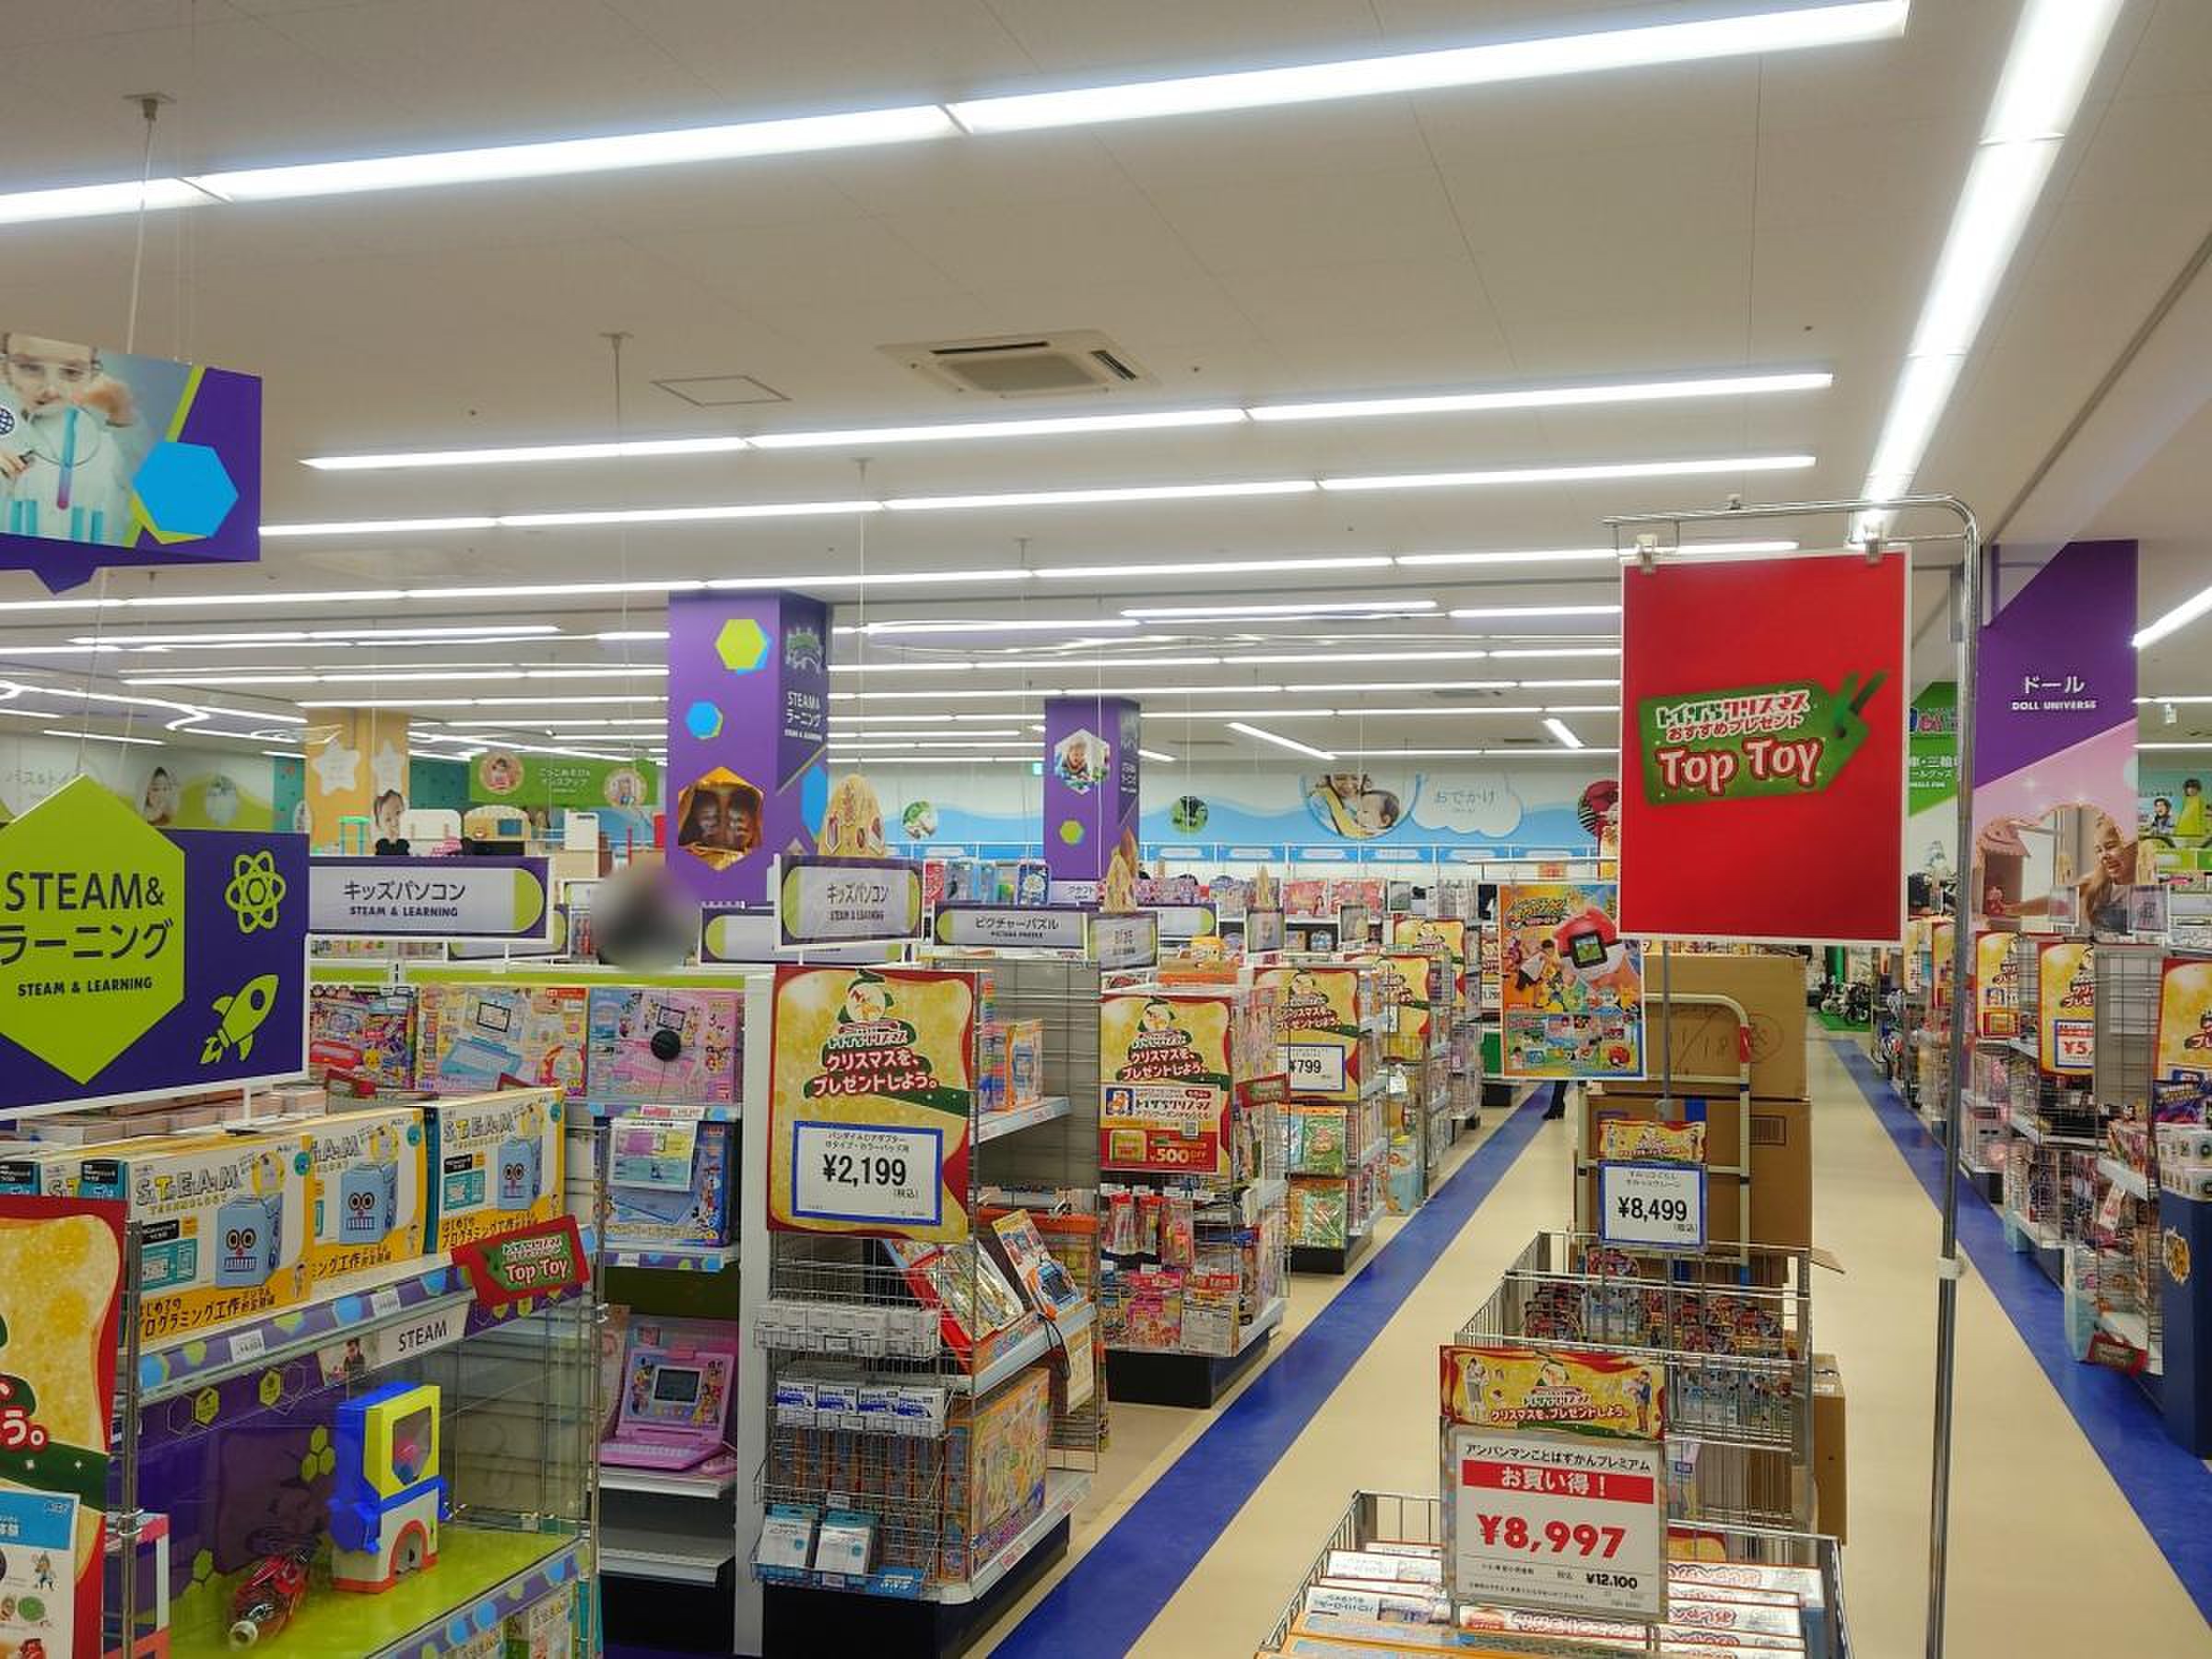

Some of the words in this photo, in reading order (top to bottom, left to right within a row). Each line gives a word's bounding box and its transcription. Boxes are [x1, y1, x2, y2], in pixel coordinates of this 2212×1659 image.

[2024, 676, 2085, 693] ドール
[2011, 700, 2040, 710] DOLL
[2043, 700, 2097, 710] UNIVERSE
[1658, 747, 1736, 794] Top
[1745, 737, 1820, 785] Toy
[5, 871, 166, 912] STEAM&
[343, 880, 466, 901] キッズパソコン
[828, 884, 889, 905] キッズパソコン
[349, 906, 385, 917] STEAM
[390, 907, 399, 917] &
[403, 906, 458, 917] LEARNING
[974, 916, 1060, 931] ピクチャーパズル
[0, 918, 174, 965] ラーニング
[18, 981, 65, 997] STEAM
[71, 981, 80, 994] &
[88, 976, 153, 993] LEARNING
[826, 1049, 920, 1073] クリスマスを、
[813, 1071, 937, 1096] プレゼントしよう。
[824, 1154, 906, 1187] ¥2,199
[136, 1165, 238, 1206] STEAM
[1618, 1197, 1688, 1222] ¥8,499
[505, 1264, 535, 1284] Top
[539, 1258, 568, 1279] Toy
[397, 1321, 447, 1352] STEAM
[1477, 1513, 1626, 1559] ¥8,997
